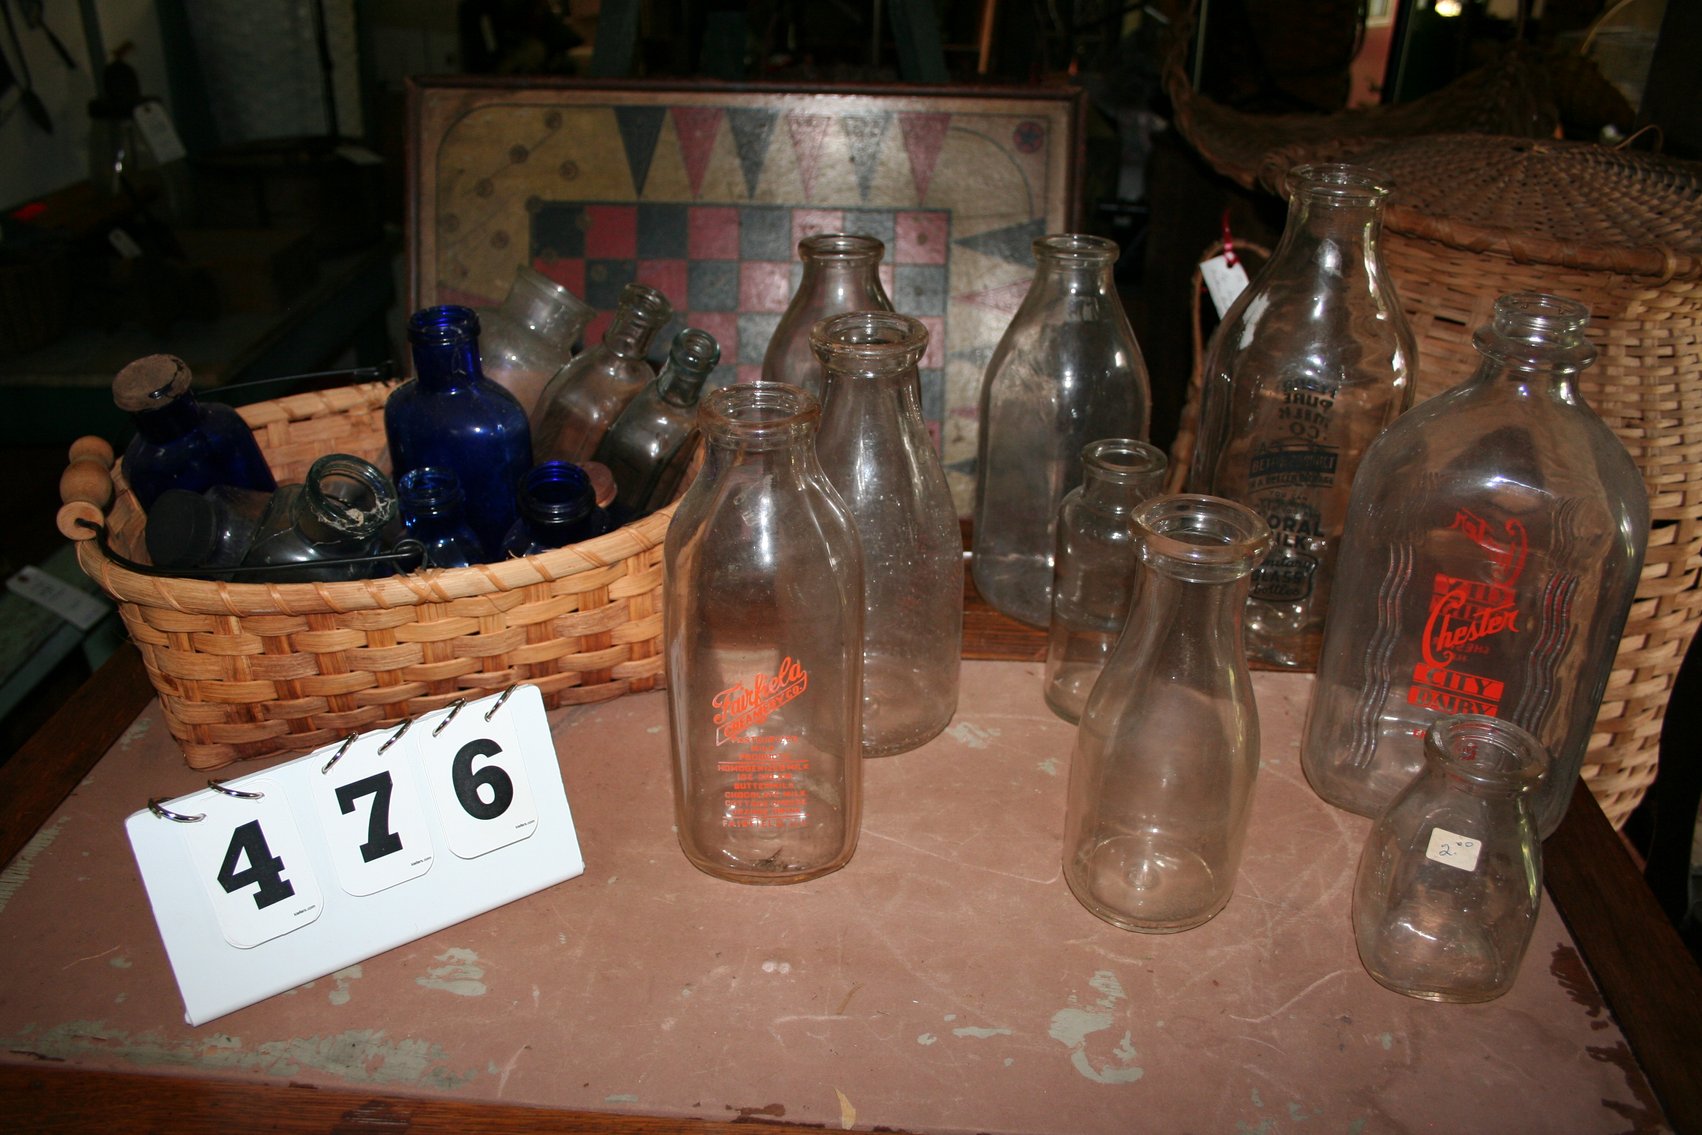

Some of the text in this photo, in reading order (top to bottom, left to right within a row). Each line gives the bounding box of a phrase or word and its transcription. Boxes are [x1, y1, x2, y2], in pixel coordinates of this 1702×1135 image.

[1267, 514, 1324, 538] ORAL
[1277, 532, 1307, 550] ILK
[1422, 590, 1519, 668] Chester
[712, 656, 804, 725] Fairfield
[1426, 667, 1493, 696] CITY
[1416, 690, 1493, 715] DAIRY
